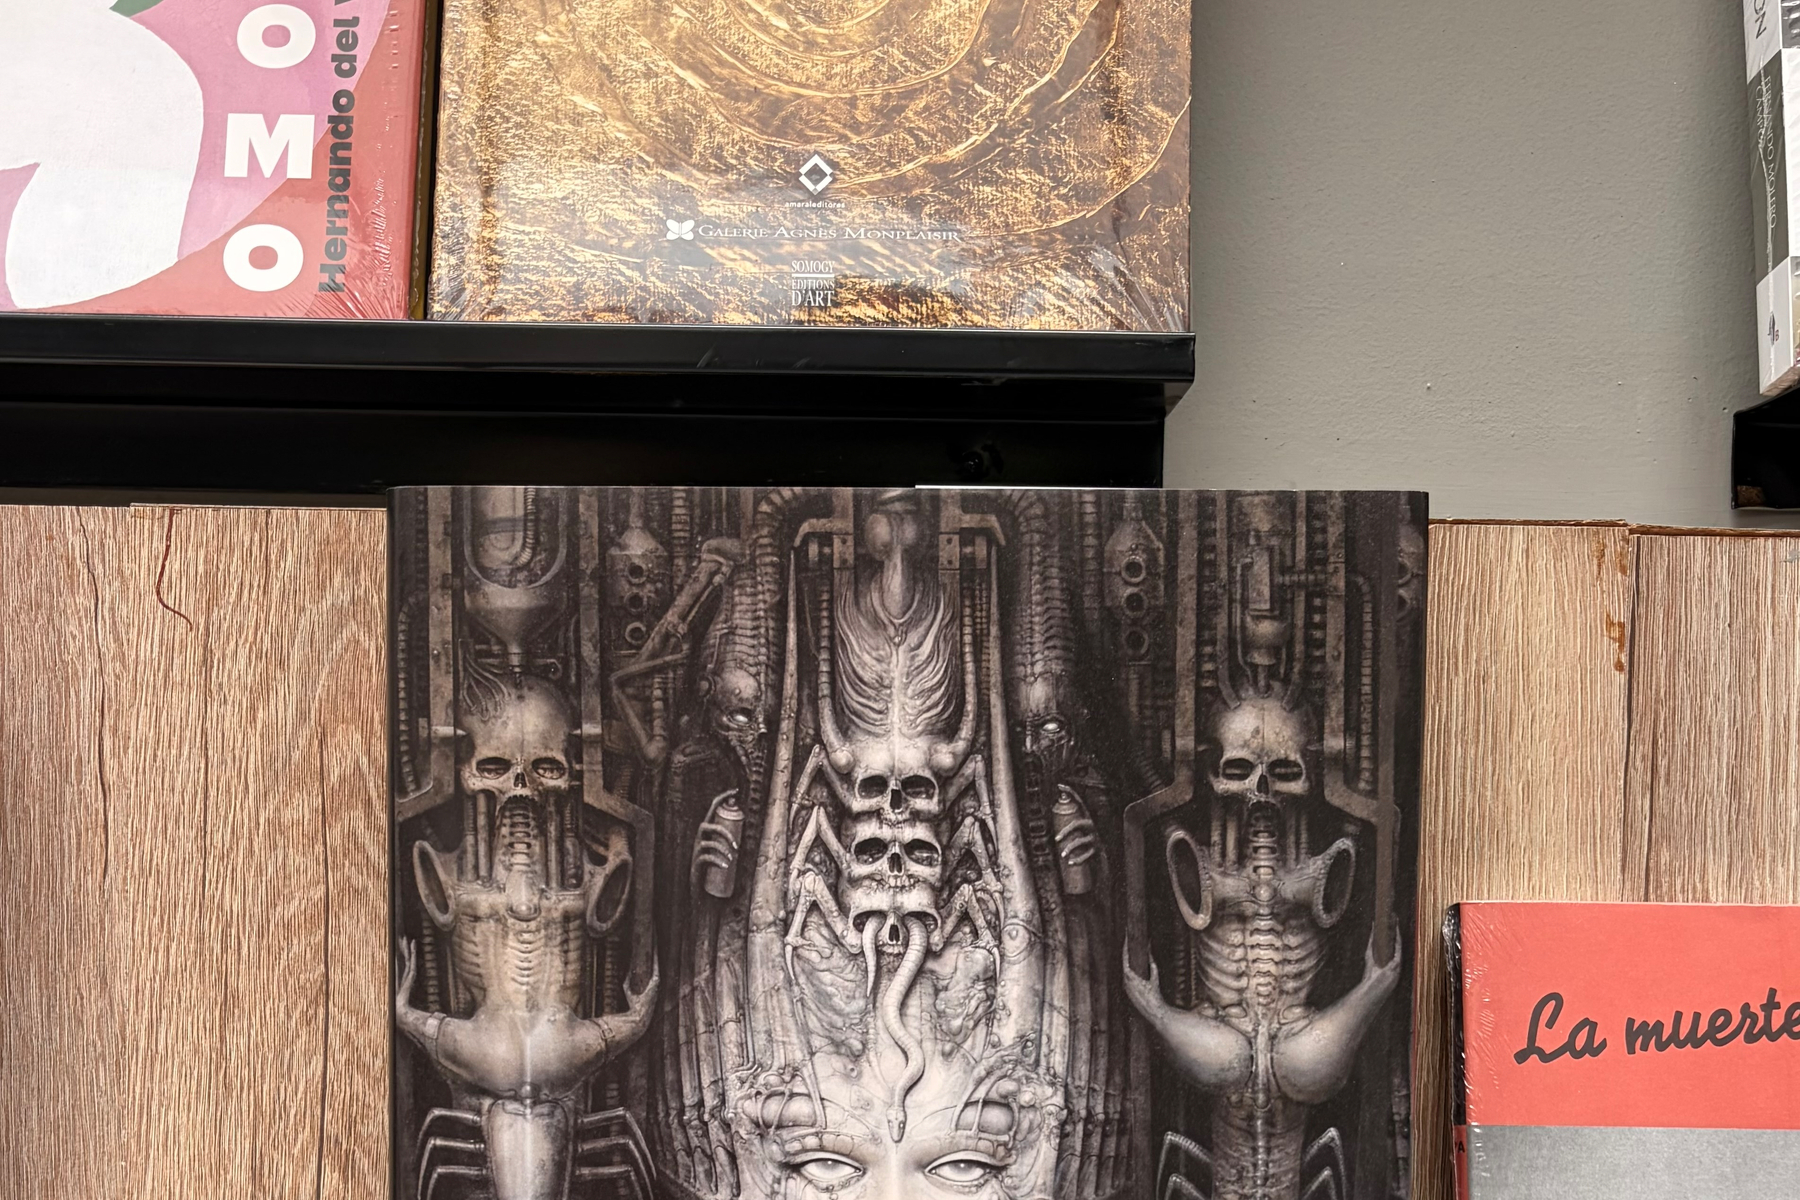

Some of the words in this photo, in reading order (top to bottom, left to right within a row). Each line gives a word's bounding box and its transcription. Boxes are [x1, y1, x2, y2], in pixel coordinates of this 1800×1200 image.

[331, 16, 360, 79] del
[318, 89, 356, 293] Hernando
[791, 260, 835, 273] SOMOGY
[1513, 991, 1608, 1065] La
[1625, 987, 1800, 1056] muerte
